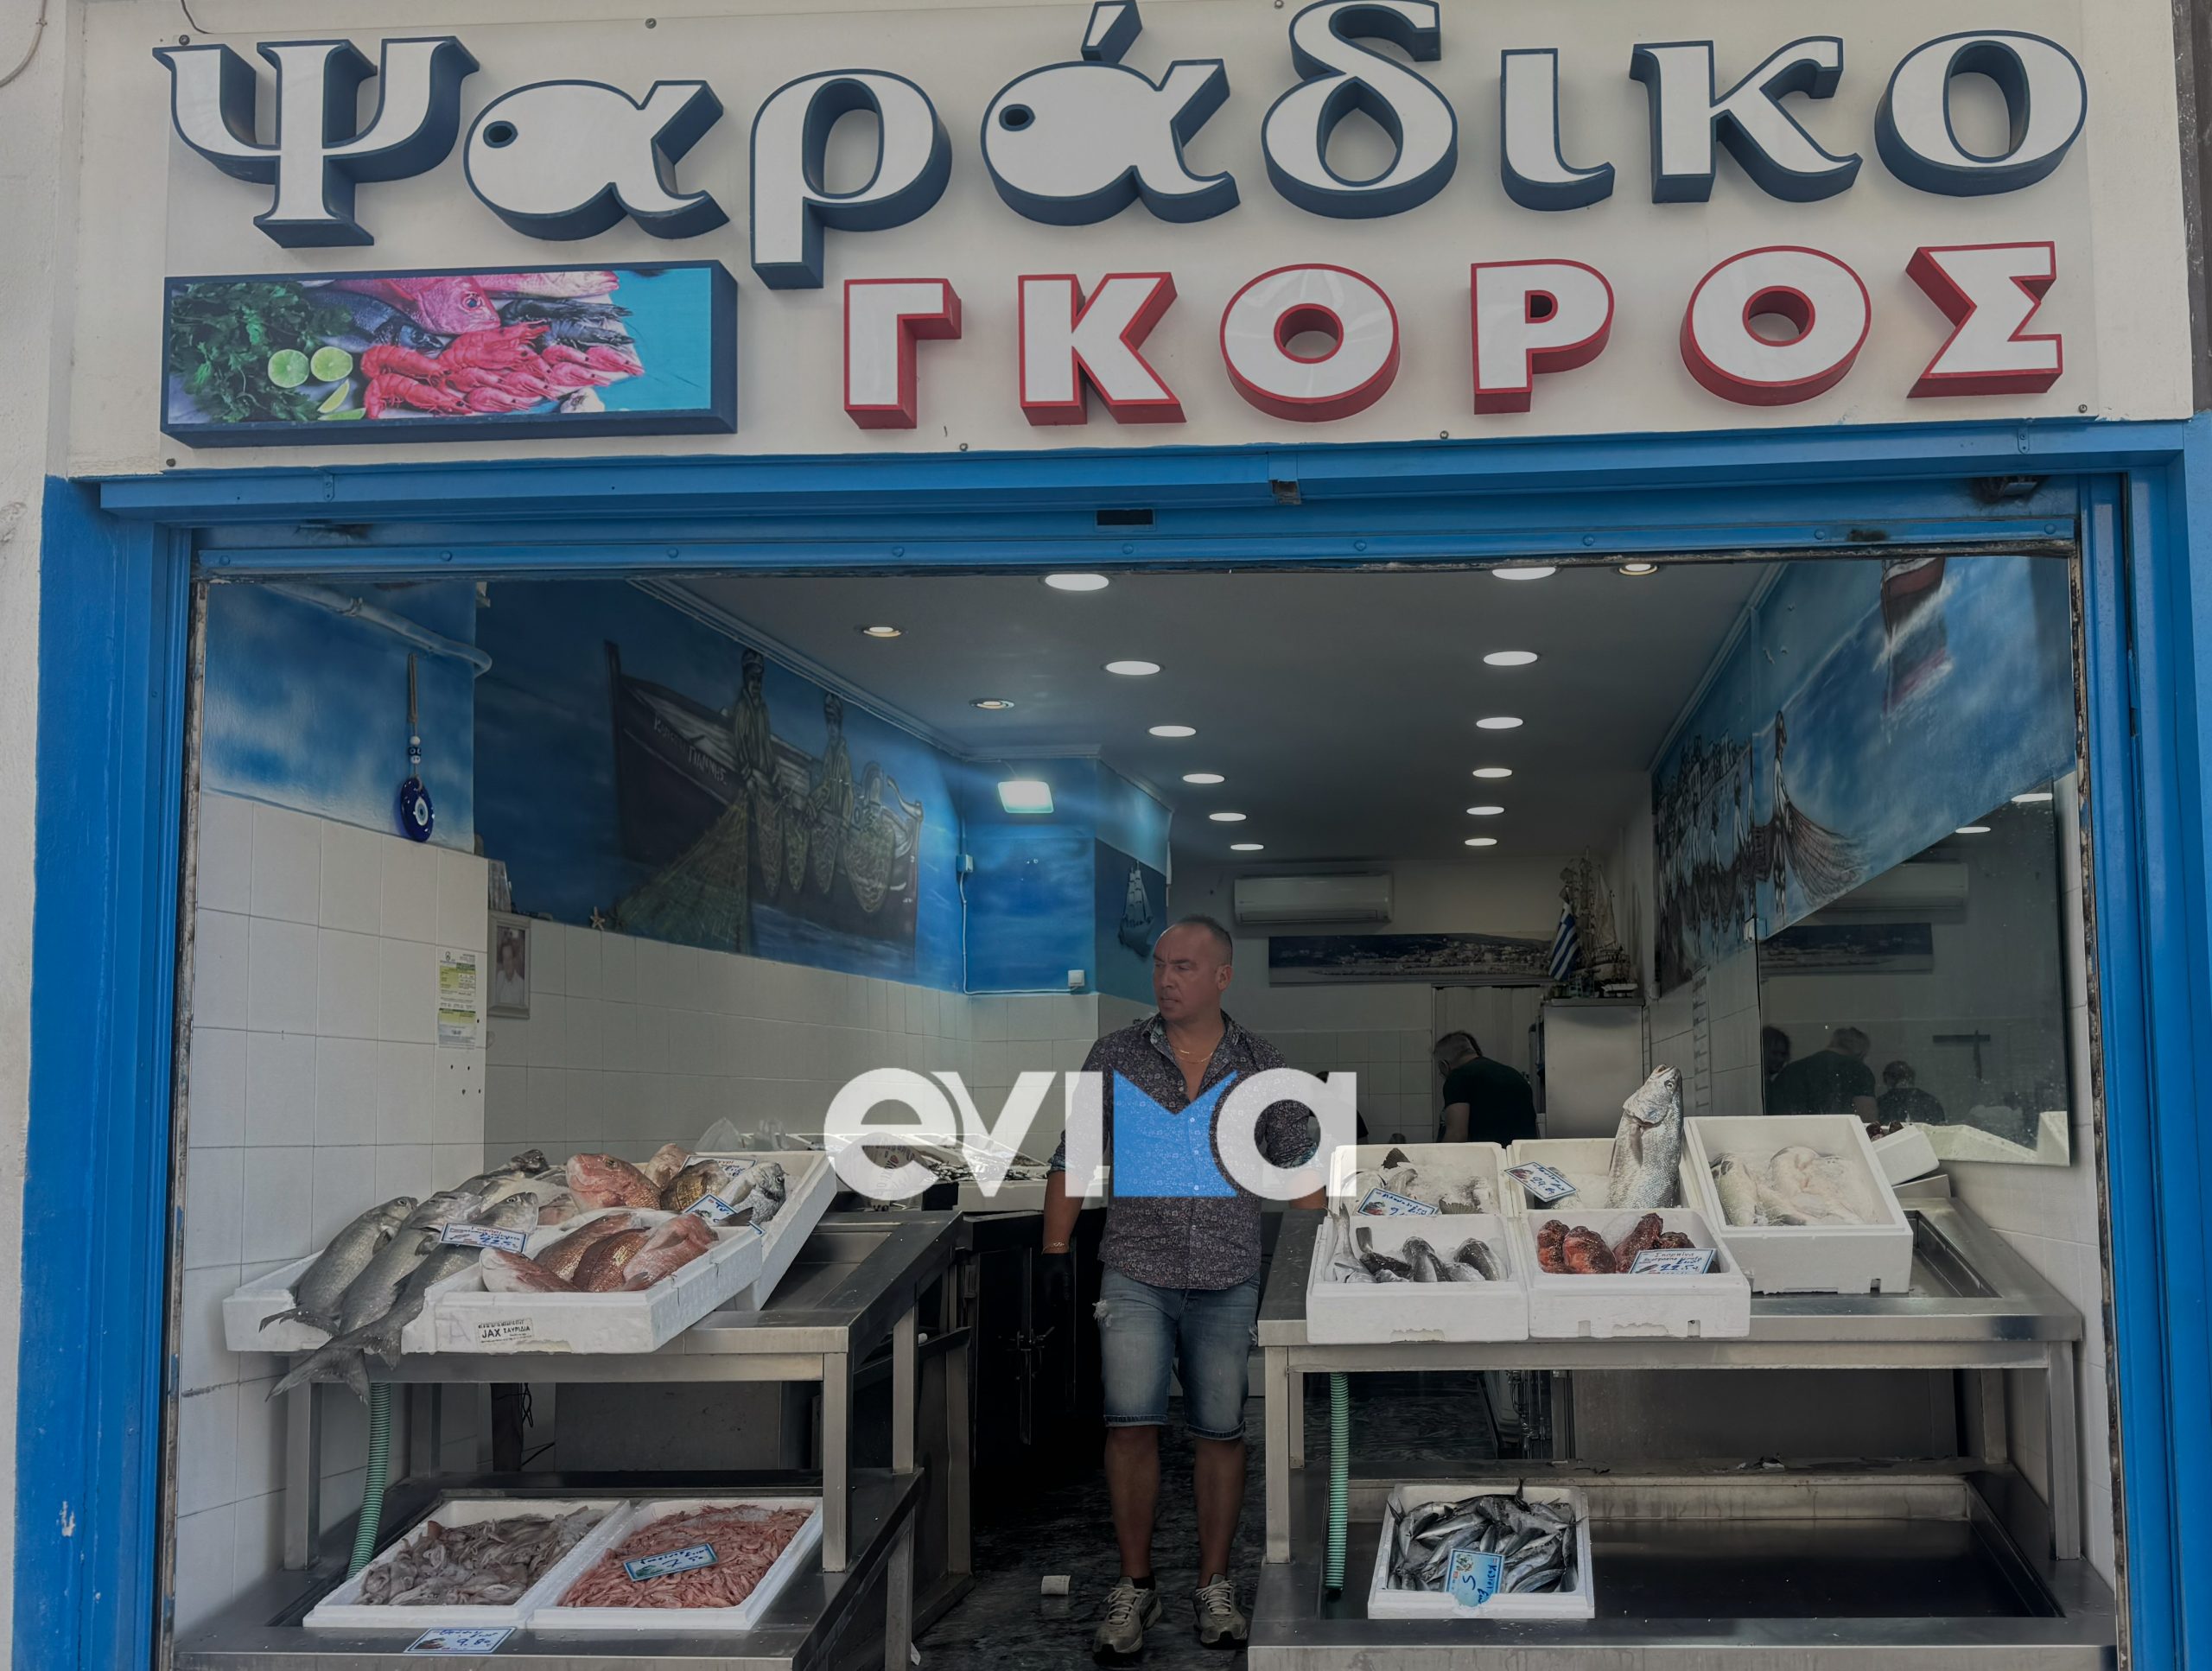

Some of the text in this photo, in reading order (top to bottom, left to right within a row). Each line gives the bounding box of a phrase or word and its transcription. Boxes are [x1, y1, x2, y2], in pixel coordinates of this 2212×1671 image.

[154, 0, 2088, 289] Ψαράδικο
[843, 241, 2063, 429] ΓΚΟΡΟΣ
[481, 1328, 502, 1338] JAX
